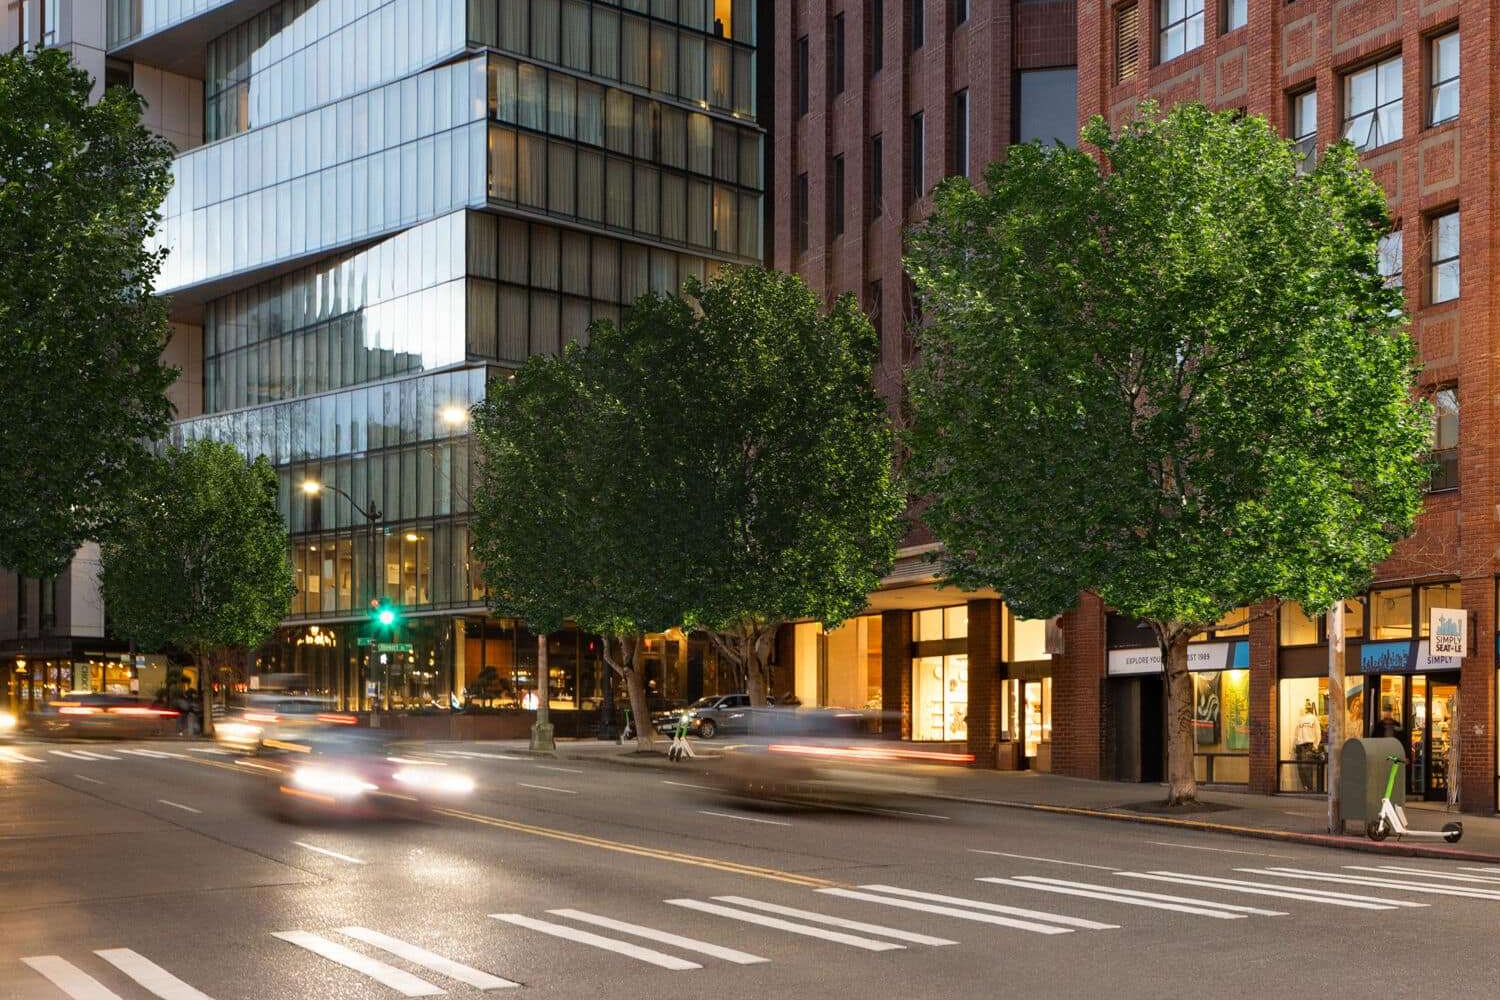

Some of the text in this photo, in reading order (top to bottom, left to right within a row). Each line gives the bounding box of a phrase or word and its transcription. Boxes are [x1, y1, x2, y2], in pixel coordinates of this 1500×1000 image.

[1436, 635, 1462, 644] SIMPLY
[1126, 656, 1149, 665] EXPLORE
[1427, 656, 1453, 664] SIMPLY
